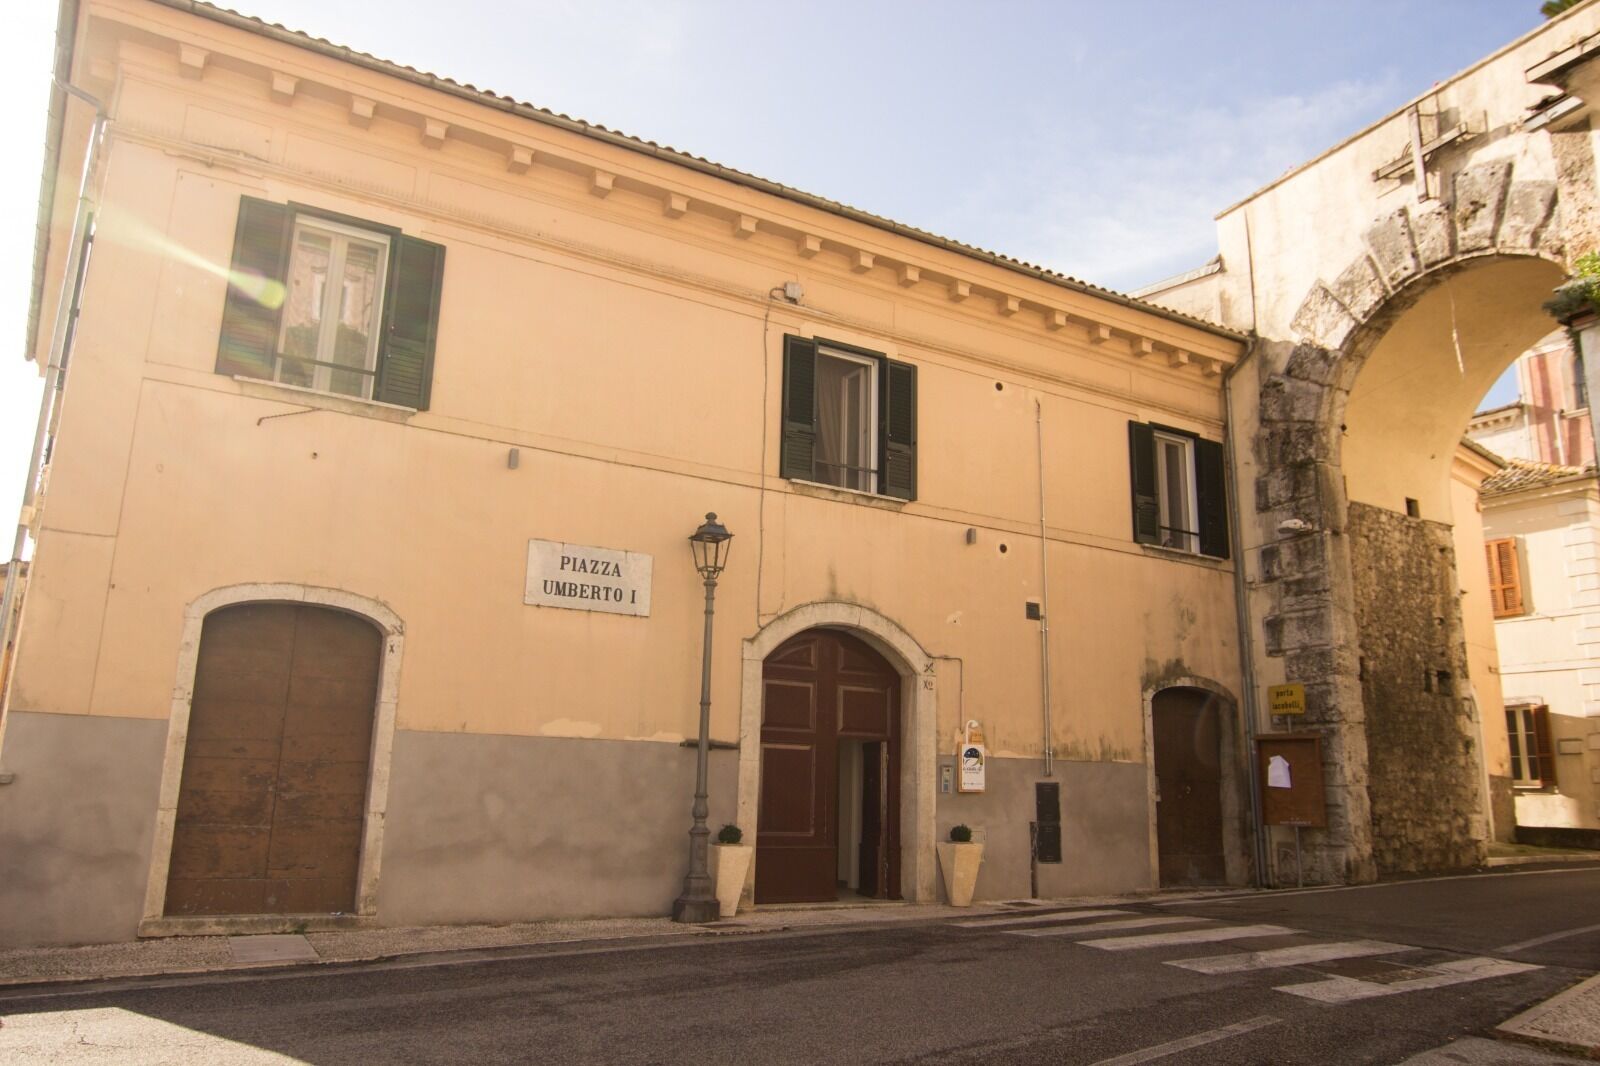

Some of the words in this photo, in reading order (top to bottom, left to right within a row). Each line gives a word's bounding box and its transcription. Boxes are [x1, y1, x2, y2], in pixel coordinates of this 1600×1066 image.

[560, 555, 622, 578] PIAZZA
[543, 579, 623, 603] UMBERTO
[630, 589, 637, 604] I
